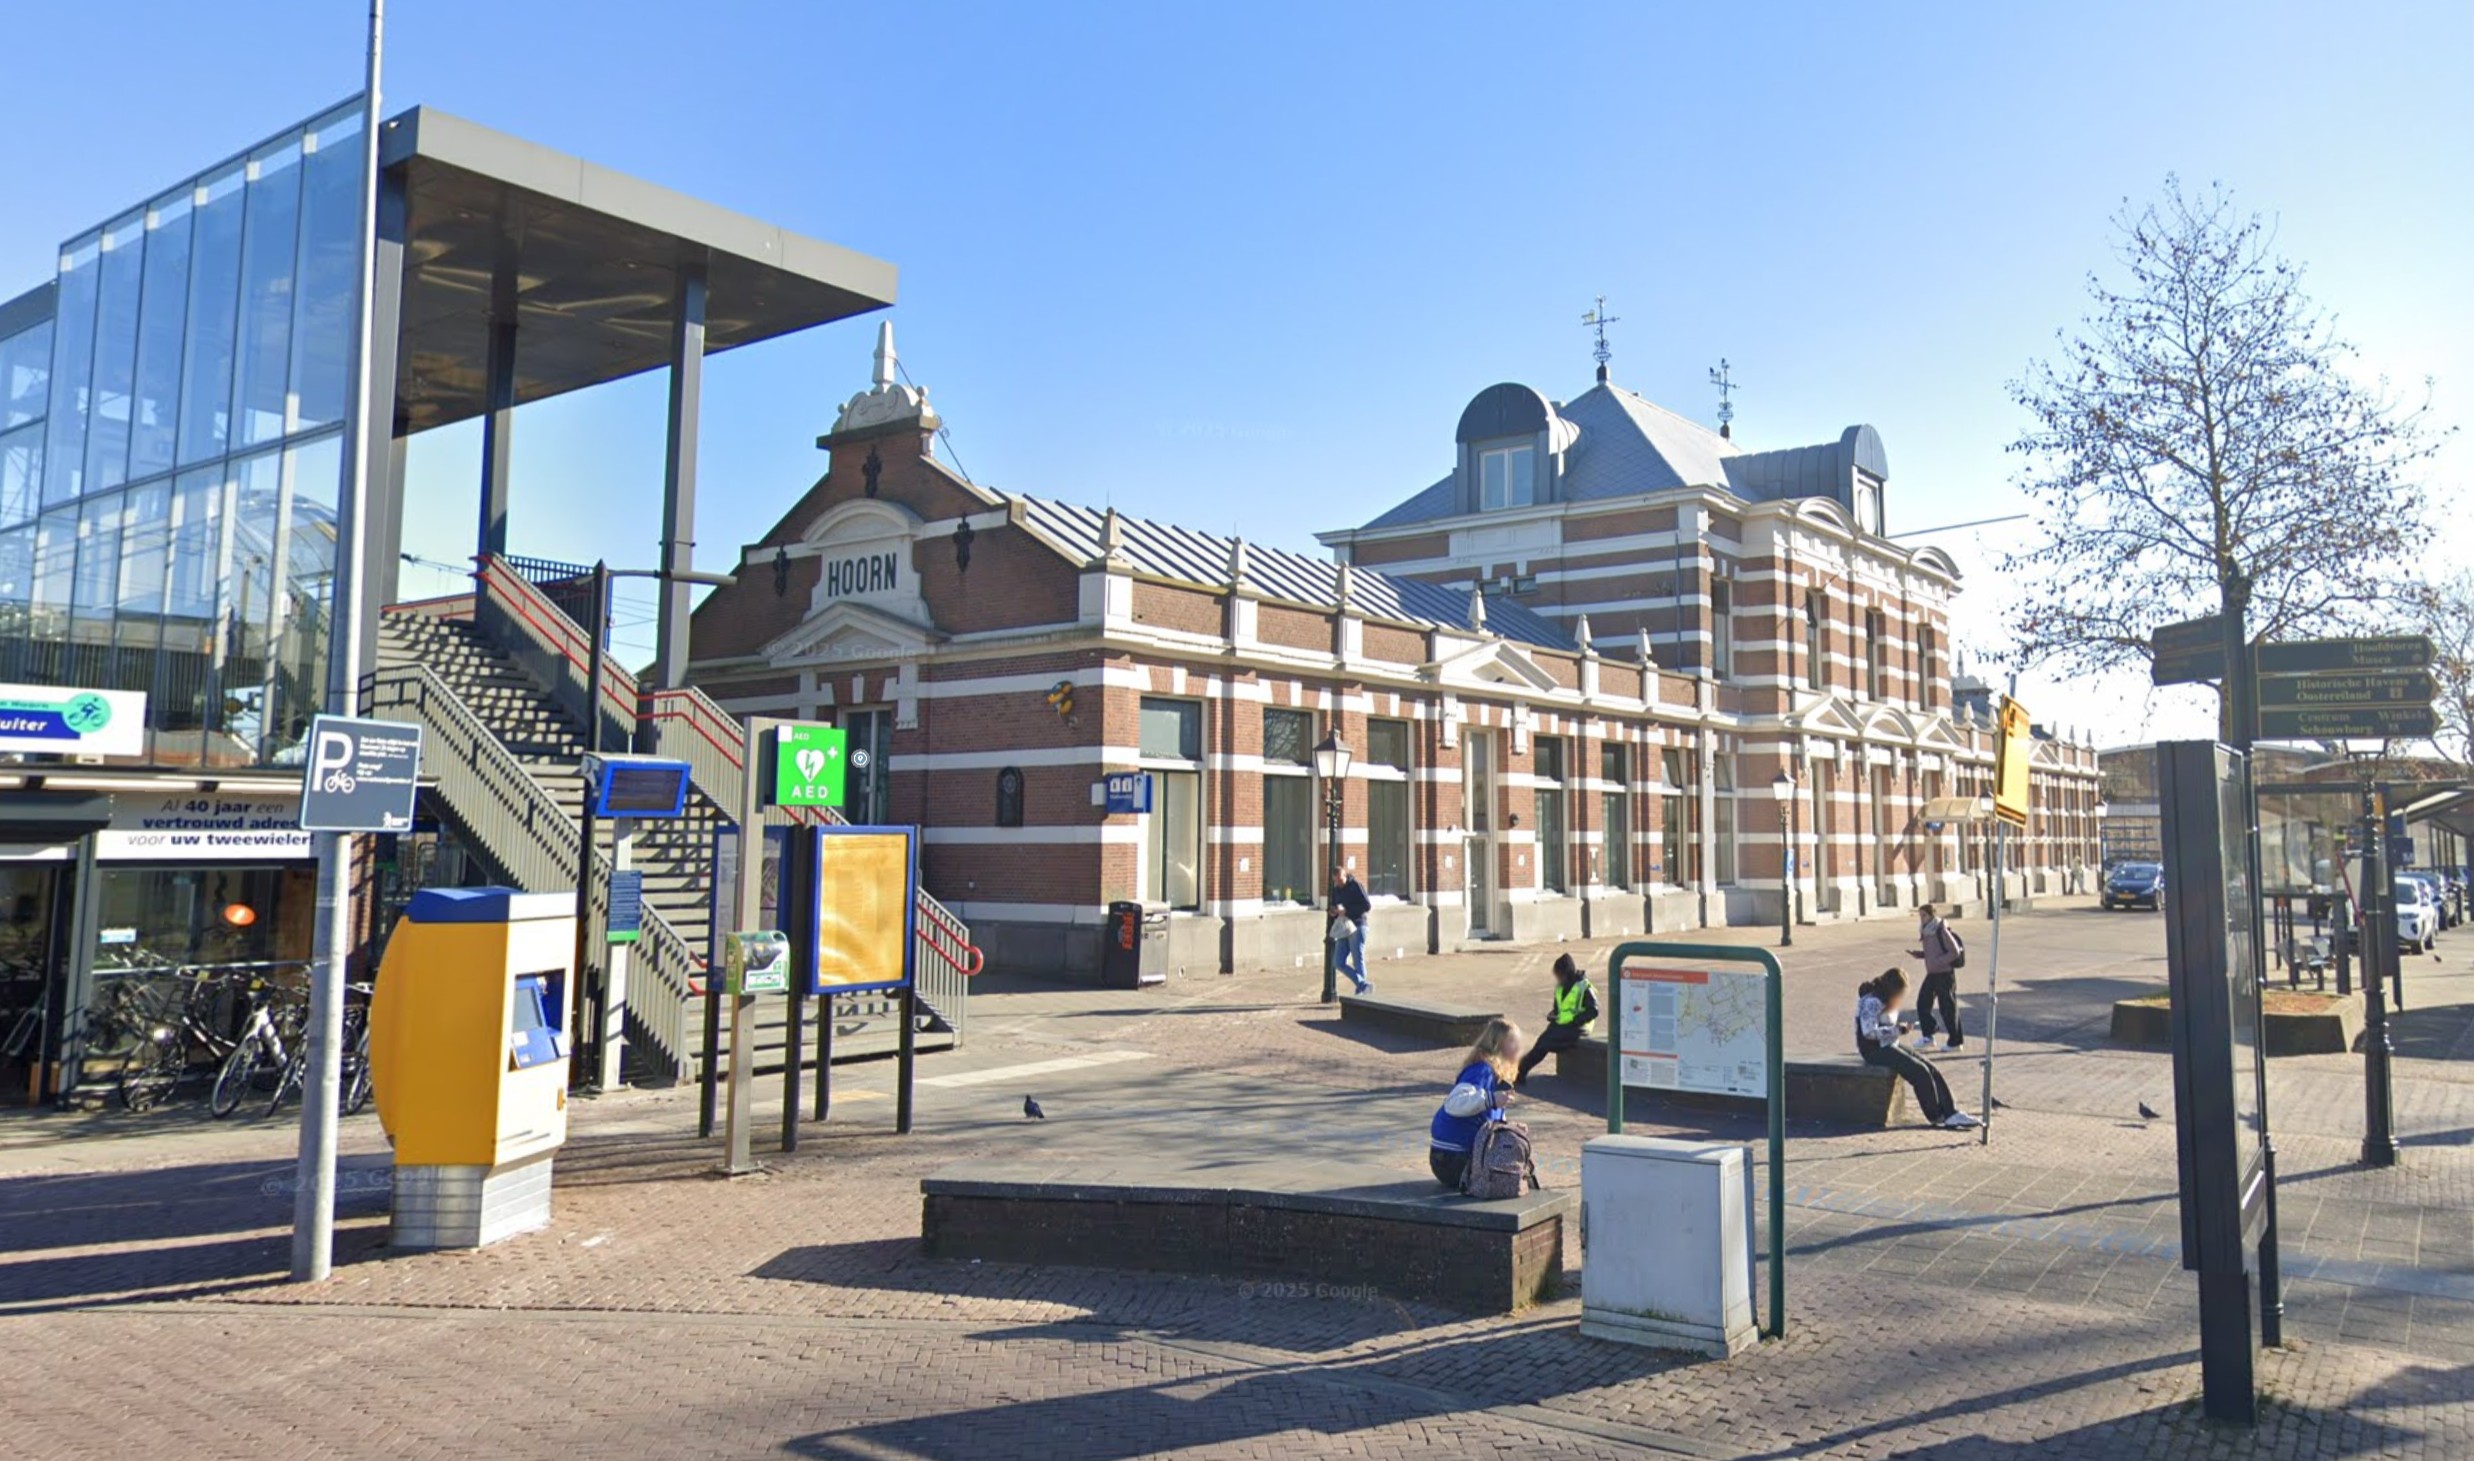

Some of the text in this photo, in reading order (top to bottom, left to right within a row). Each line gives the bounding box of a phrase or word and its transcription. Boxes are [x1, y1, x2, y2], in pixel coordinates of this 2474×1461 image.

[827, 552, 897, 598] HOORN
[2296, 676, 2410, 690] Historische Havens
[2296, 690, 2372, 701] Oostereiland
[2297, 710, 2427, 723] Centrum Winkels
[0, 717, 48, 731] uiter
[2299, 723, 2375, 736] Schouwburg
[793, 732, 810, 741] AED
[311, 730, 353, 792] P
[791, 784, 829, 799] AED
[161, 799, 285, 815] Al 40 jaar een
[142, 816, 300, 829] vertrouwd adres
[127, 833, 315, 846] voor uw tweewieler!
